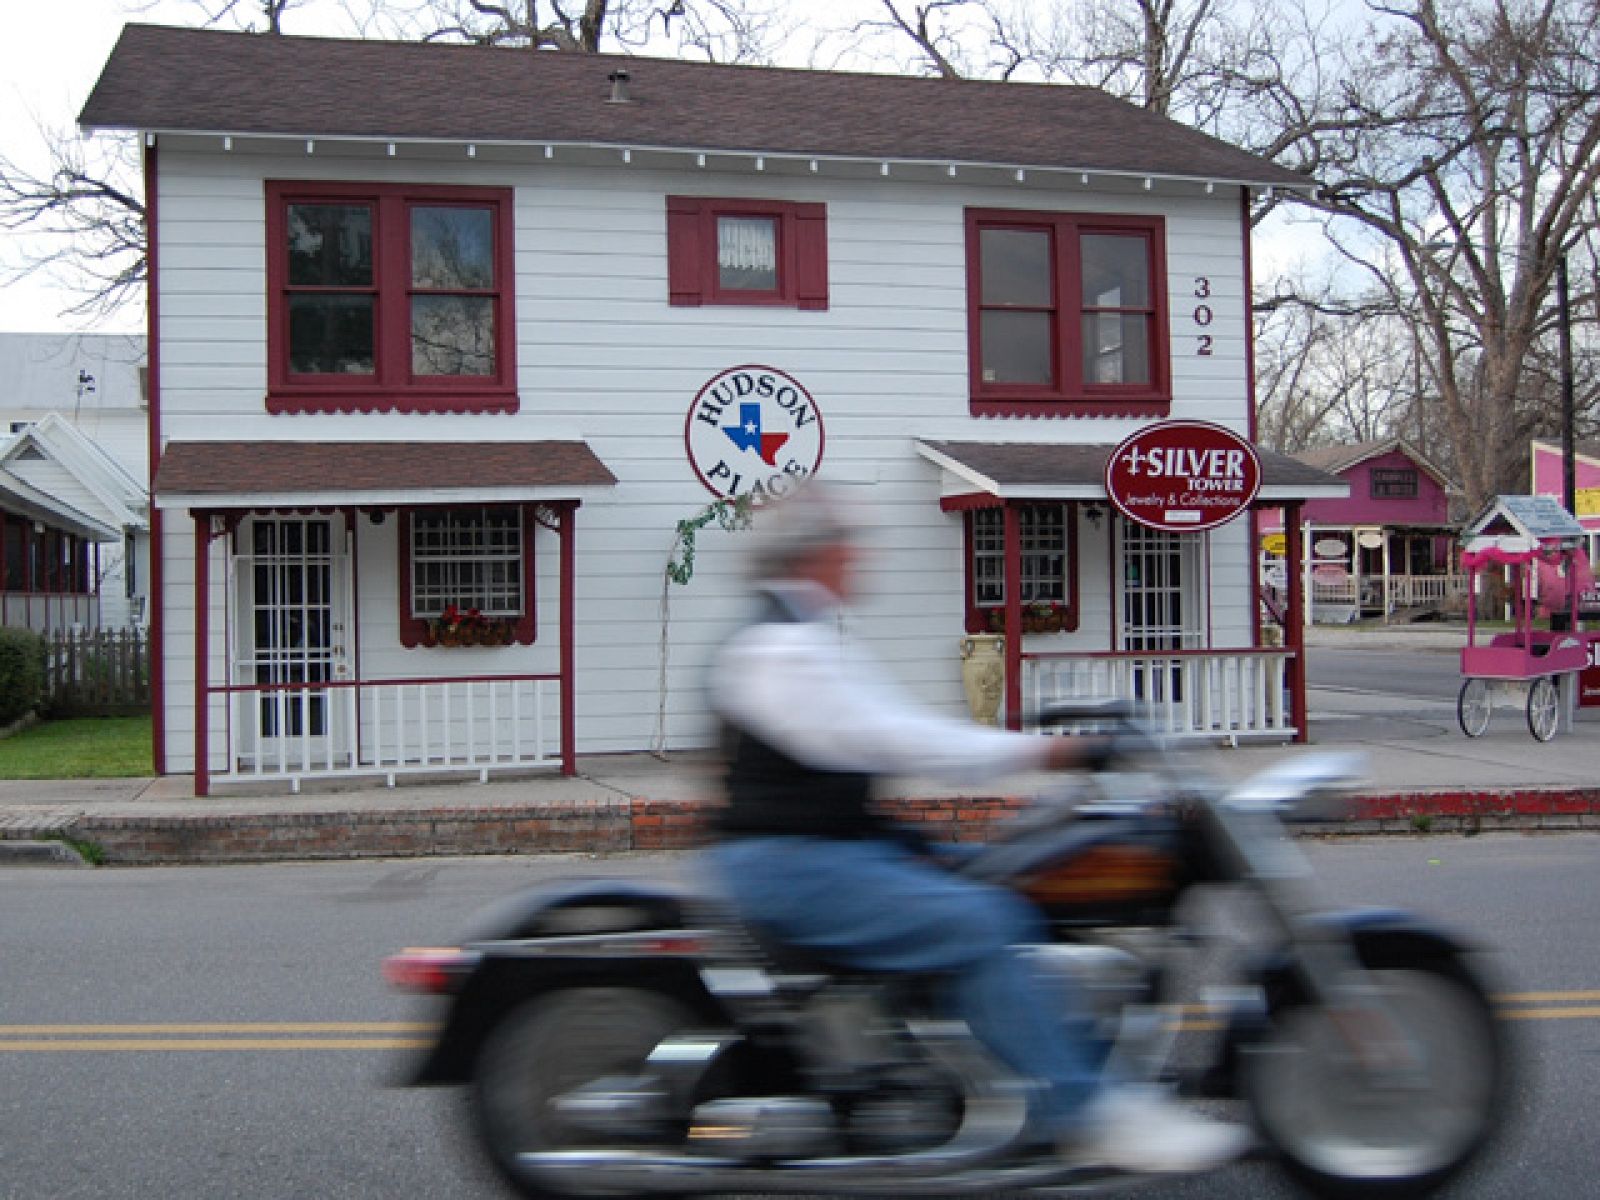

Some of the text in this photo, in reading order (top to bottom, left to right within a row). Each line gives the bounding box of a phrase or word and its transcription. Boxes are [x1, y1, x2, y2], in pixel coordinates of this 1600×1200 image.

[1193, 275, 1212, 356] 302
[696, 372, 816, 429] HUDSON
[1146, 447, 1245, 477] SILVER
